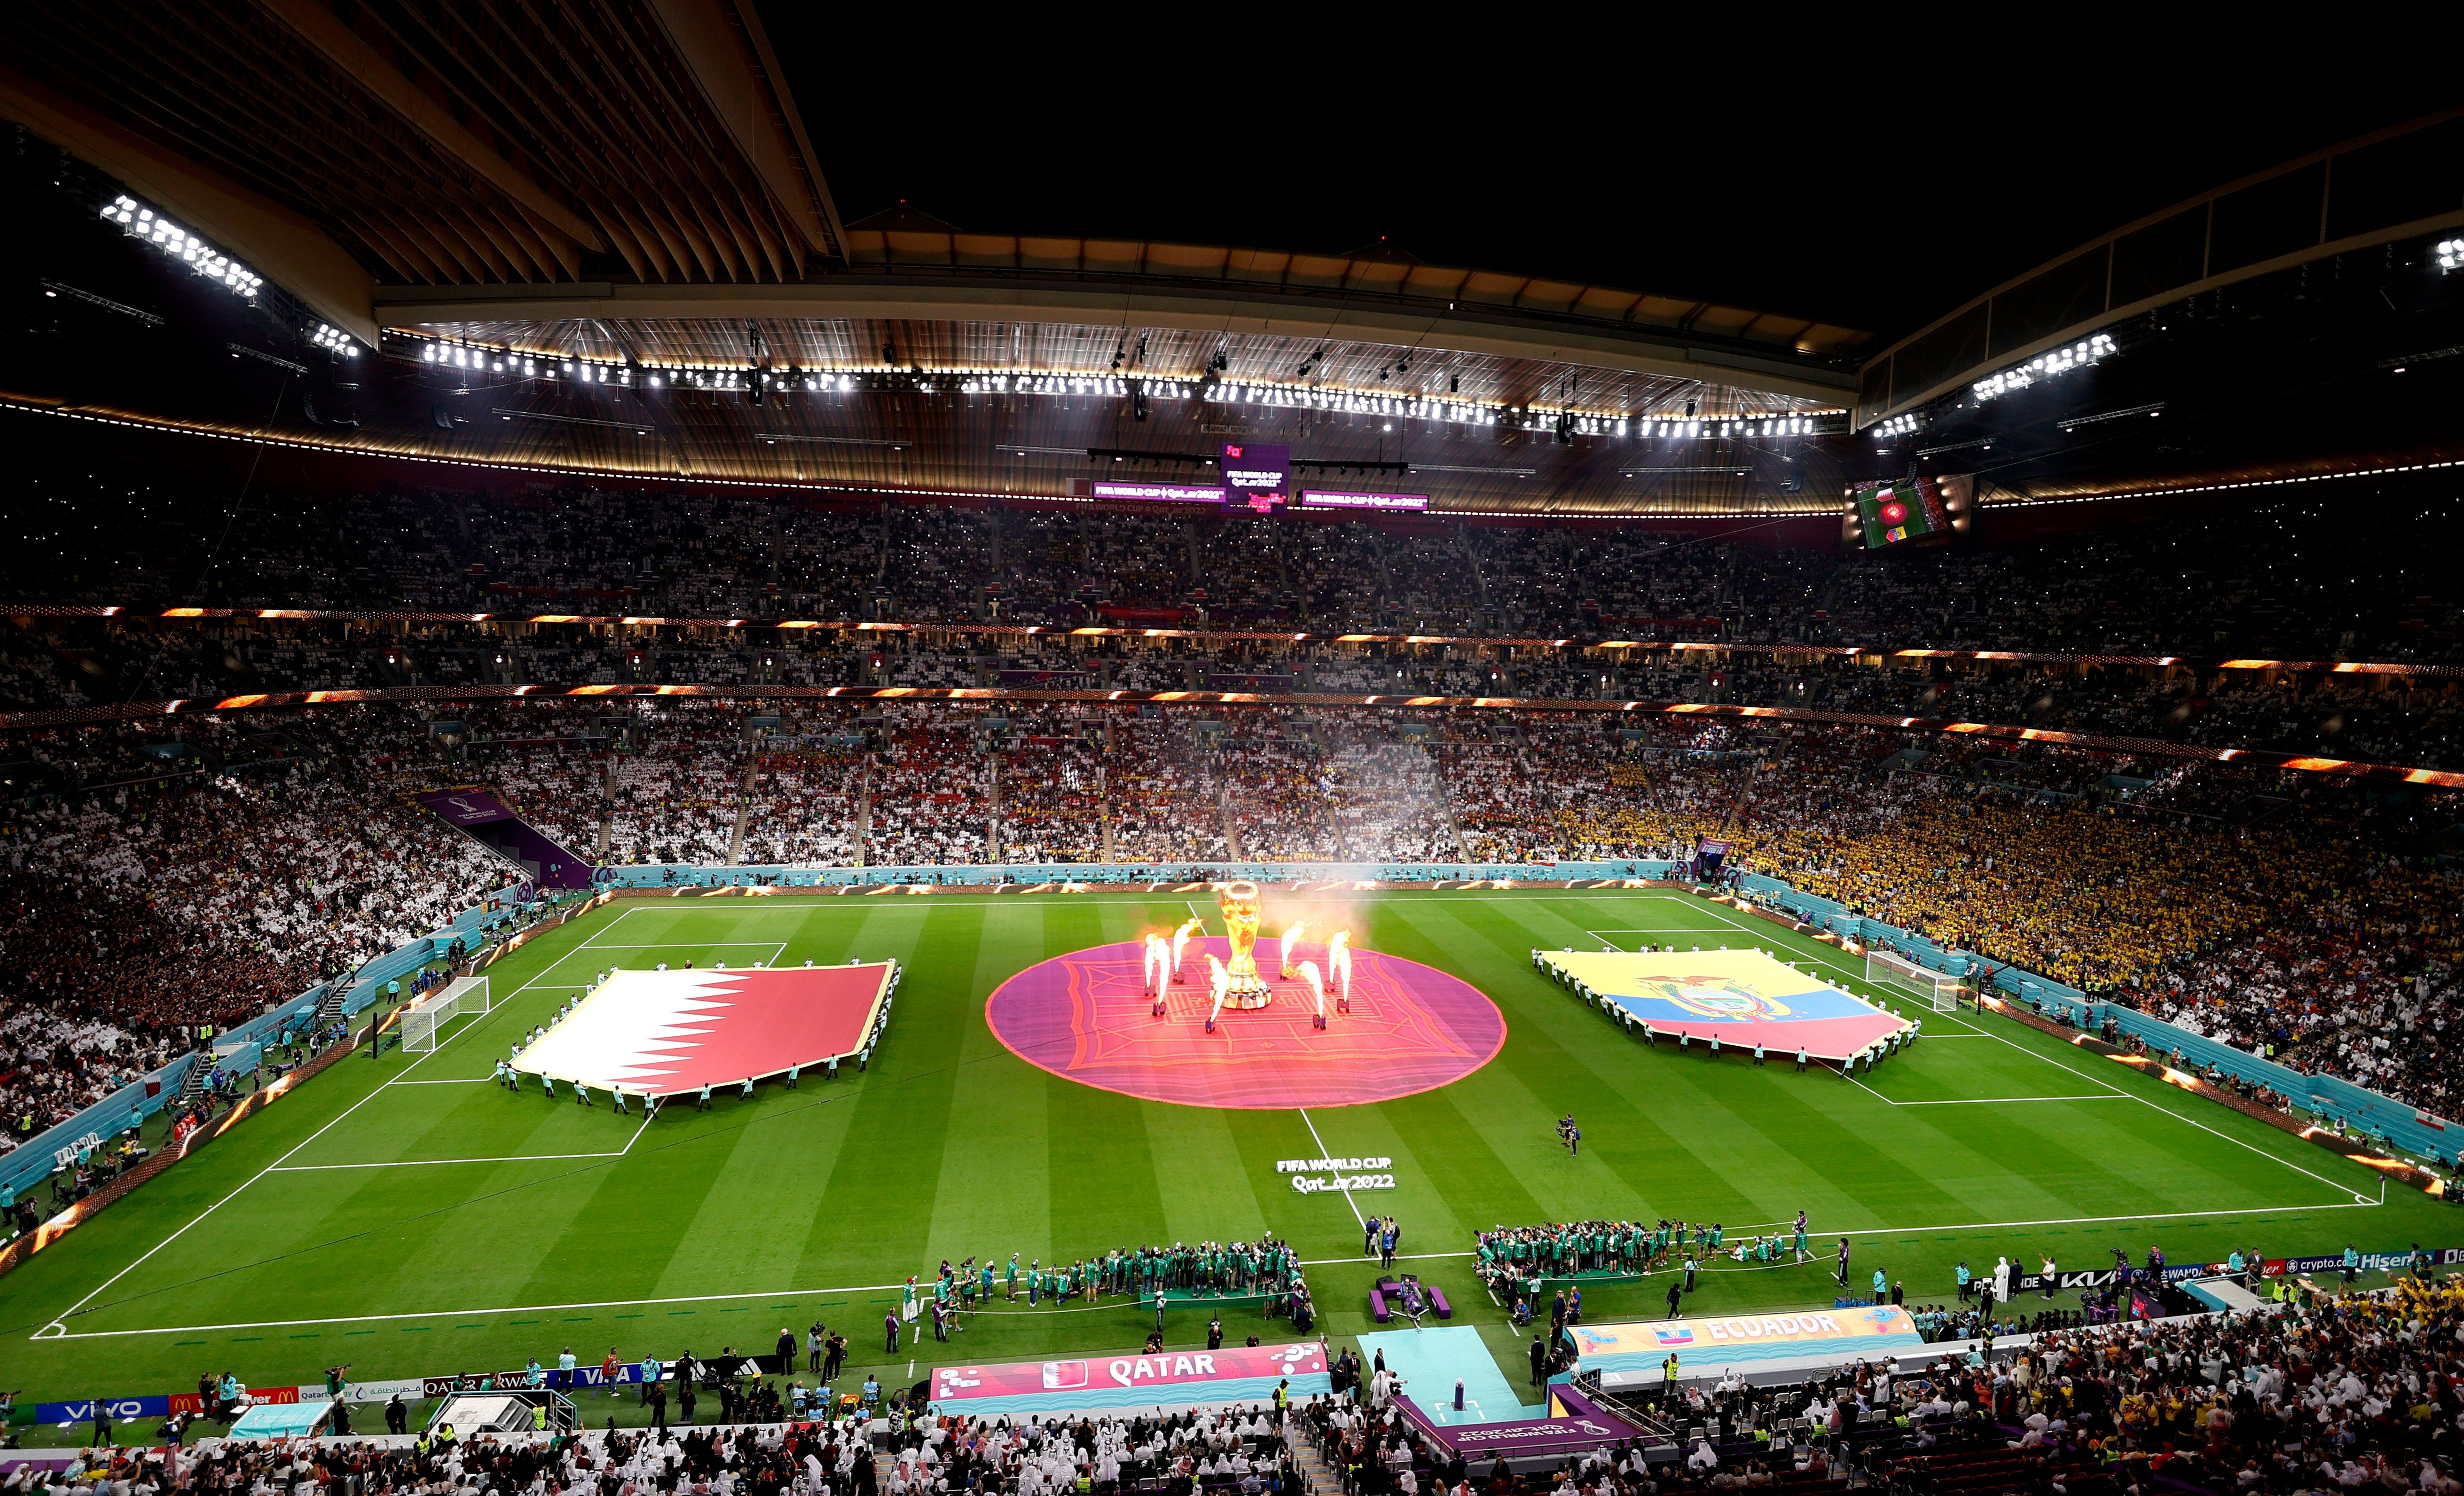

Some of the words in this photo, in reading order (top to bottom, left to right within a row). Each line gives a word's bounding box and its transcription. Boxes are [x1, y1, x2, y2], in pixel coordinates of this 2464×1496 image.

[1096, 486, 1114, 495] FIFA
[1114, 487, 1144, 496] WORLD
[1144, 488, 1161, 497] CUP
[1305, 493, 1323, 502] FIFA
[1323, 494, 1351, 504] WORLD
[1351, 495, 1367, 504] CUP
[1276, 1160, 1310, 1173] FIFA
[1308, 1159, 1363, 1171] WORLD
[1363, 1157, 1392, 1170] CUP
[2361, 1253, 2432, 1269] Hisen
[1703, 1314, 1841, 1339] ECUADOR
[581, 1367, 630, 1385] VIA
[1109, 1354, 1216, 1387] QATAR
[424, 1379, 477, 1394] QATR
[301, 1390, 353, 1400] QatarEgy
[1488, 1430, 1544, 1440] WORLD
